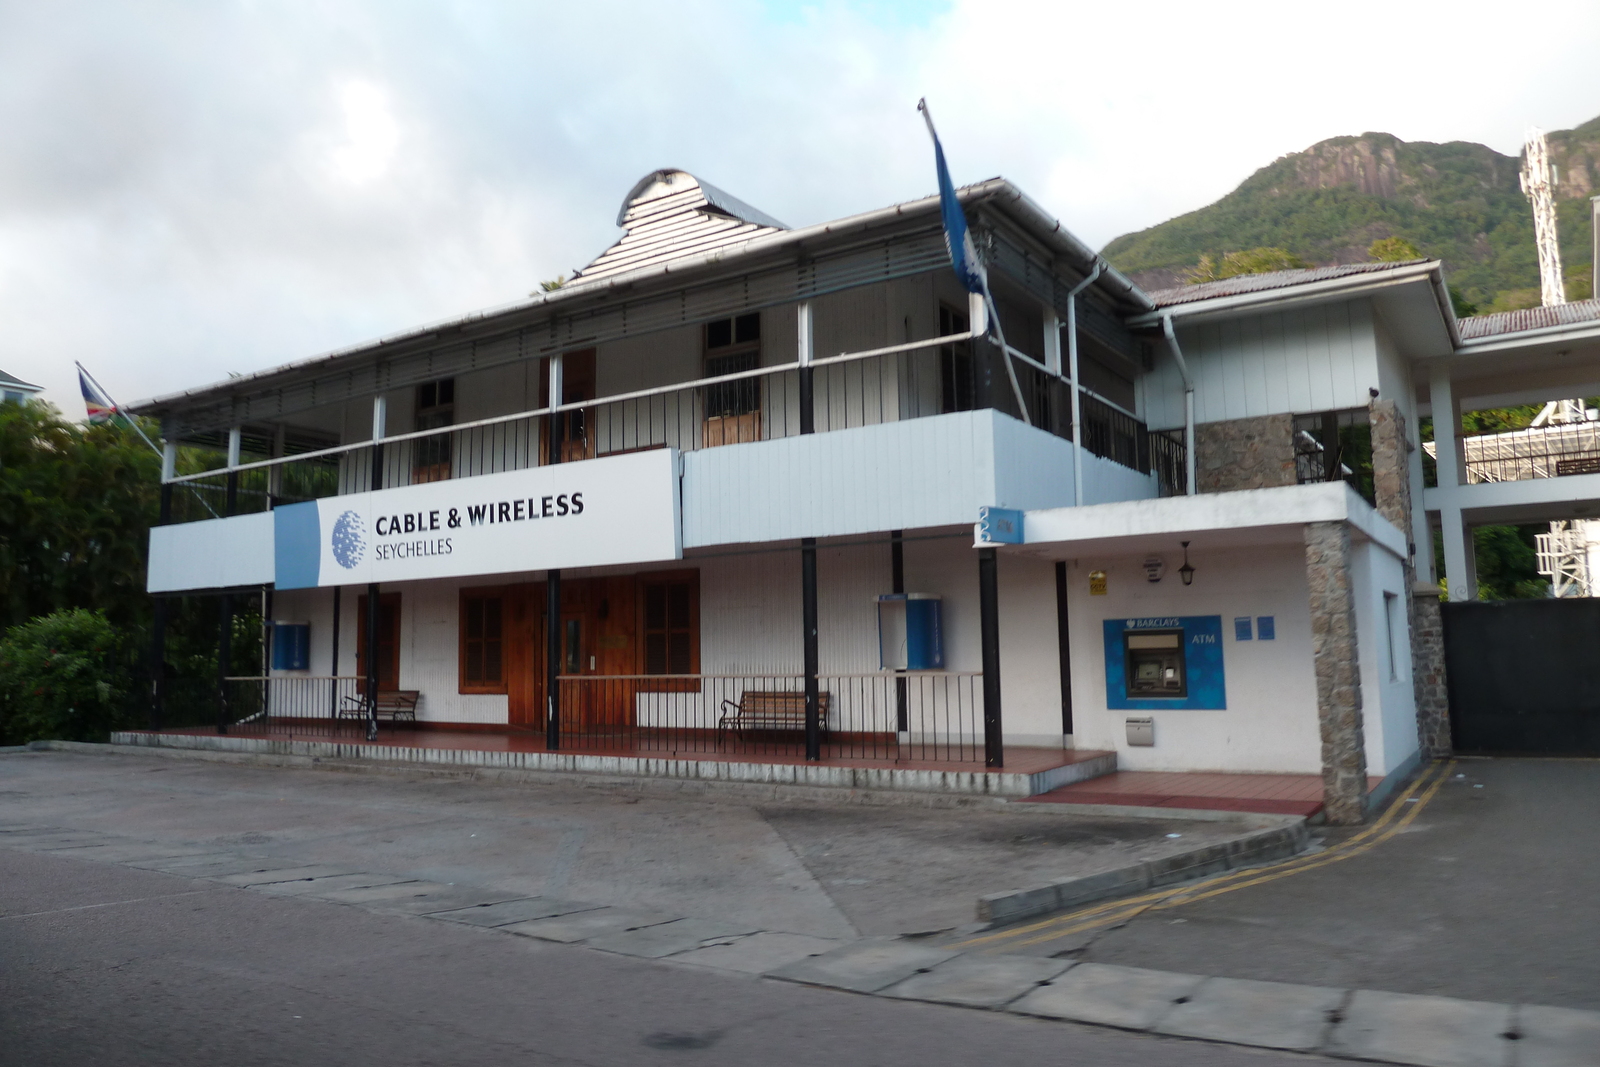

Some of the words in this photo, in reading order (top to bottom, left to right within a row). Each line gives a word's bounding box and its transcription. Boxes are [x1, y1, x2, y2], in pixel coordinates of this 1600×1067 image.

[375, 511, 440, 536] CABLE
[447, 507, 462, 529] &
[467, 492, 584, 527] WIRELESS
[375, 537, 453, 560] SEYCHELLES
[1136, 617, 1180, 628] BARCLAYS
[1192, 634, 1216, 644] ATM
